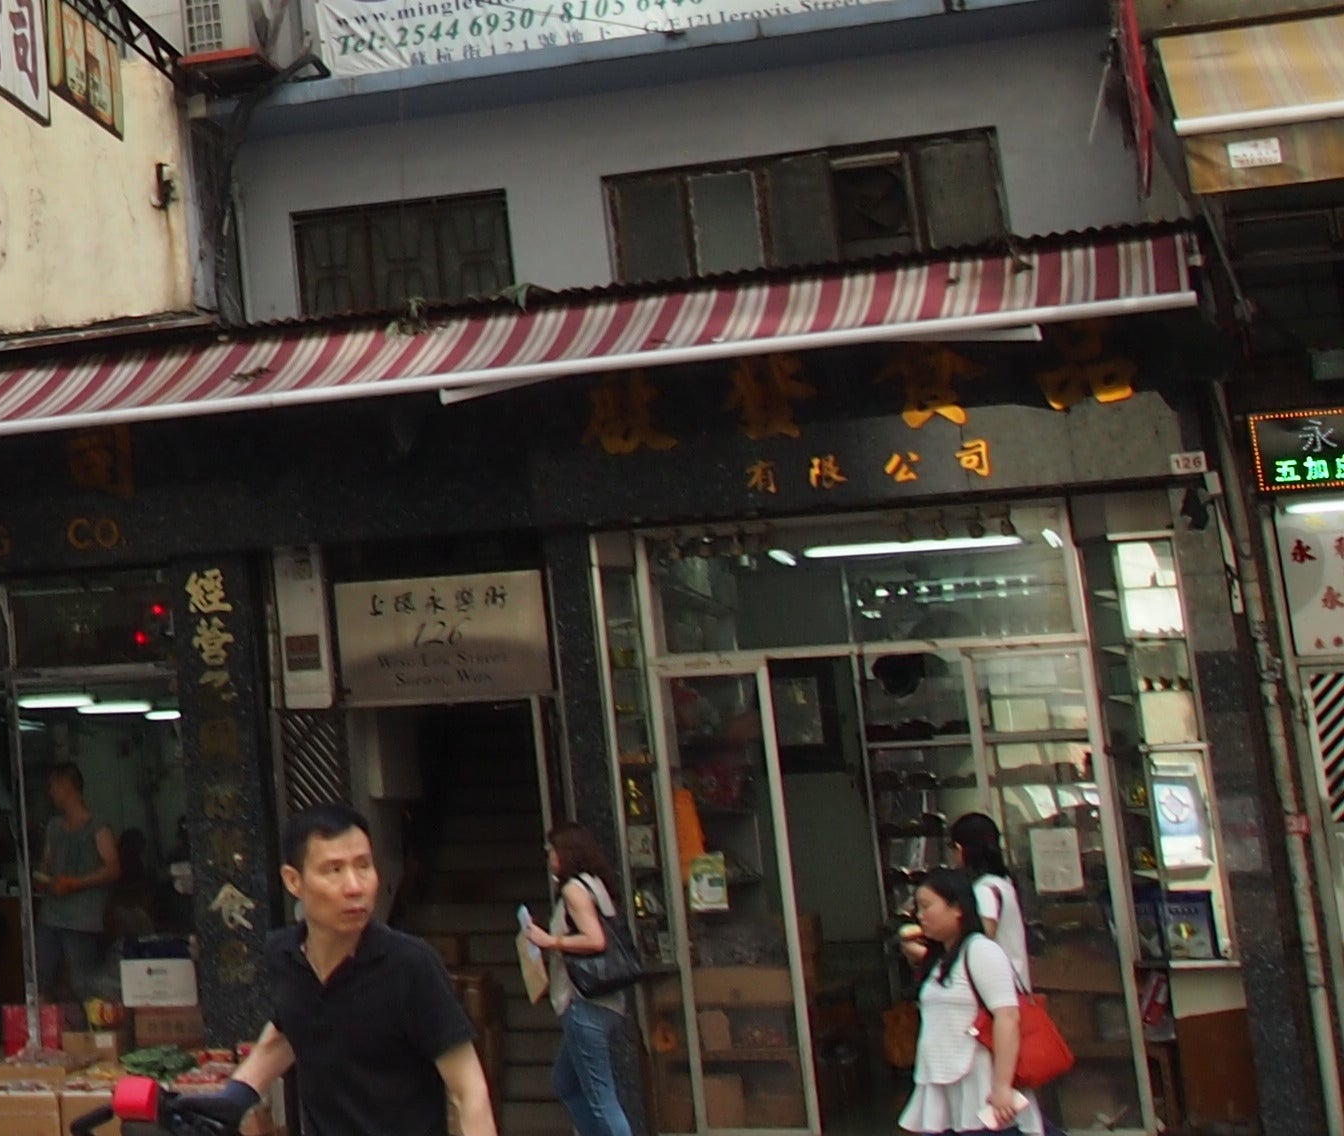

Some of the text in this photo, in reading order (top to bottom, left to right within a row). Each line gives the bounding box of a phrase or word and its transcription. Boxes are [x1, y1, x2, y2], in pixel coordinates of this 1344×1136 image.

[336, 33, 386, 57] Tel:
[395, 18, 461, 51] 2544
[744, 437, 993, 495] 有限公司
[1173, 455, 1203, 471] 126
